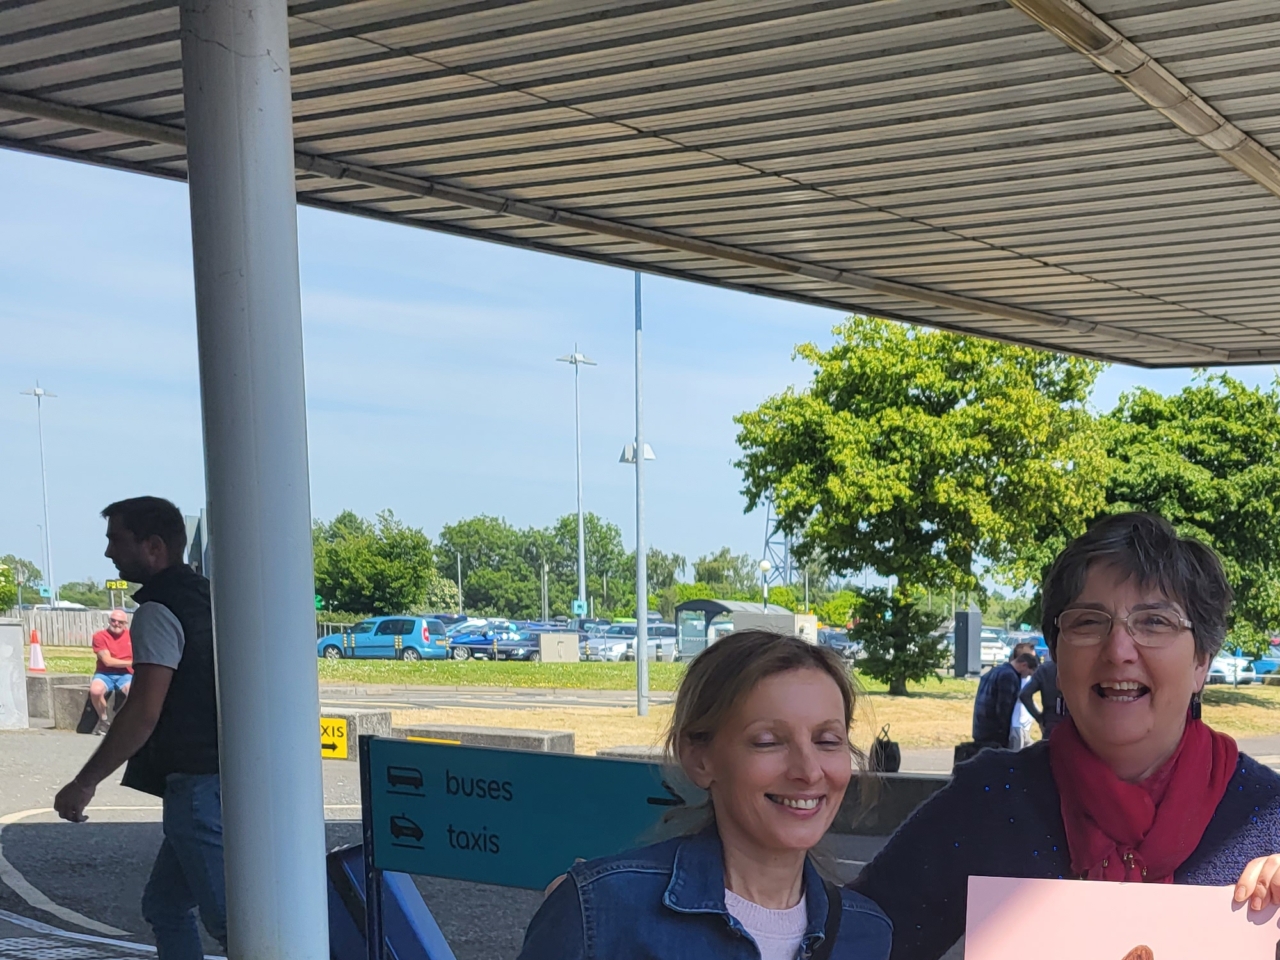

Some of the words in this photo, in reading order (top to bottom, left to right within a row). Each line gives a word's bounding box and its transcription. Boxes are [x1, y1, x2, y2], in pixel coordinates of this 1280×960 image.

[321, 726, 345, 738] XIS
[445, 769, 513, 801] buses
[446, 822, 500, 854] taxis
